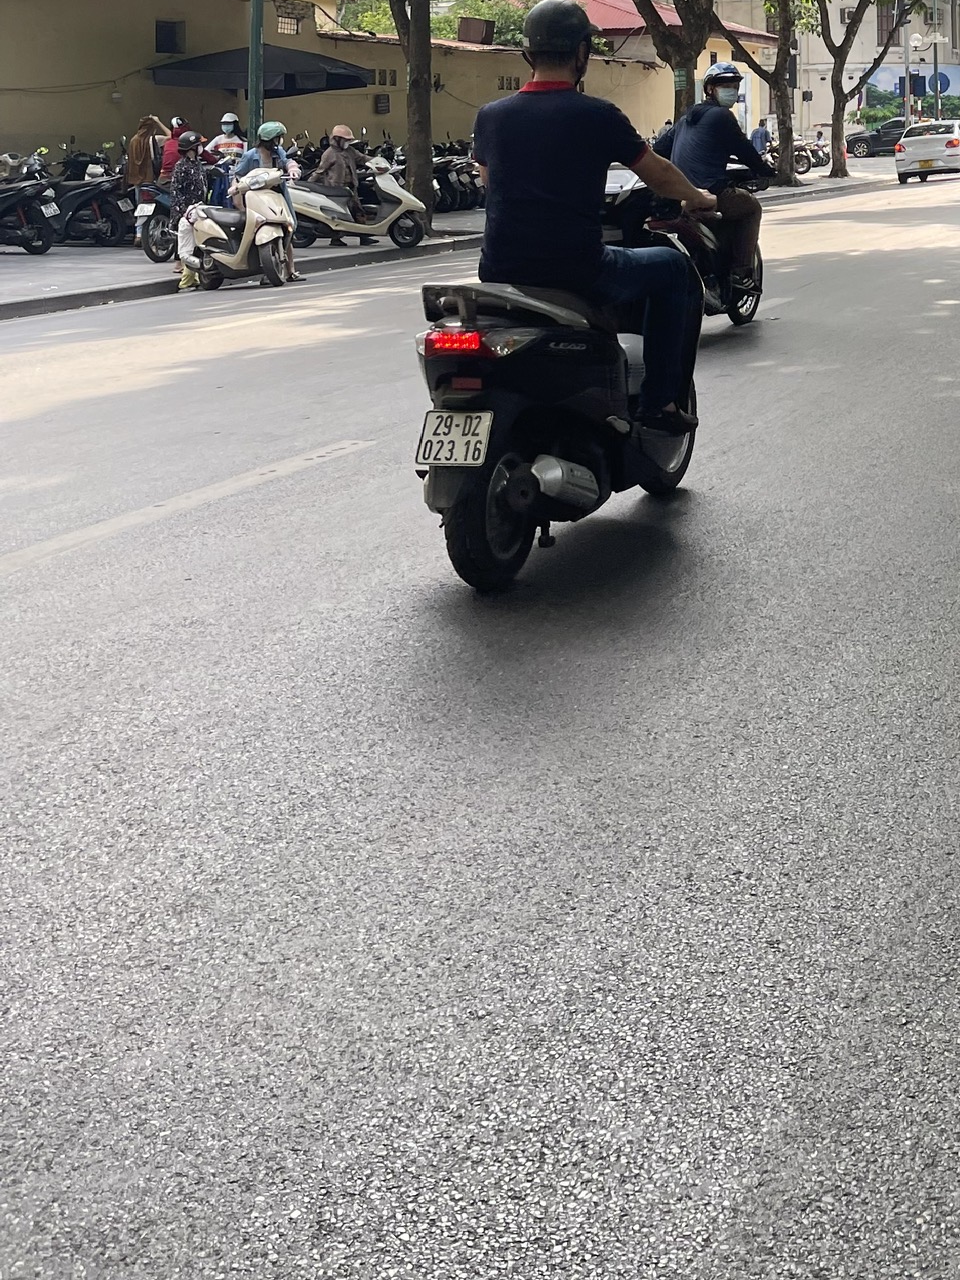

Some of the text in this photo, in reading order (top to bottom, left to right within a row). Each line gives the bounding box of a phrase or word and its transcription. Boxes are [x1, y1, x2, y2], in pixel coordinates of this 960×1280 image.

[549, 341, 587, 351] LEAD
[432, 414, 482, 437] 29-D2
[422, 439, 483, 462] 023.16
